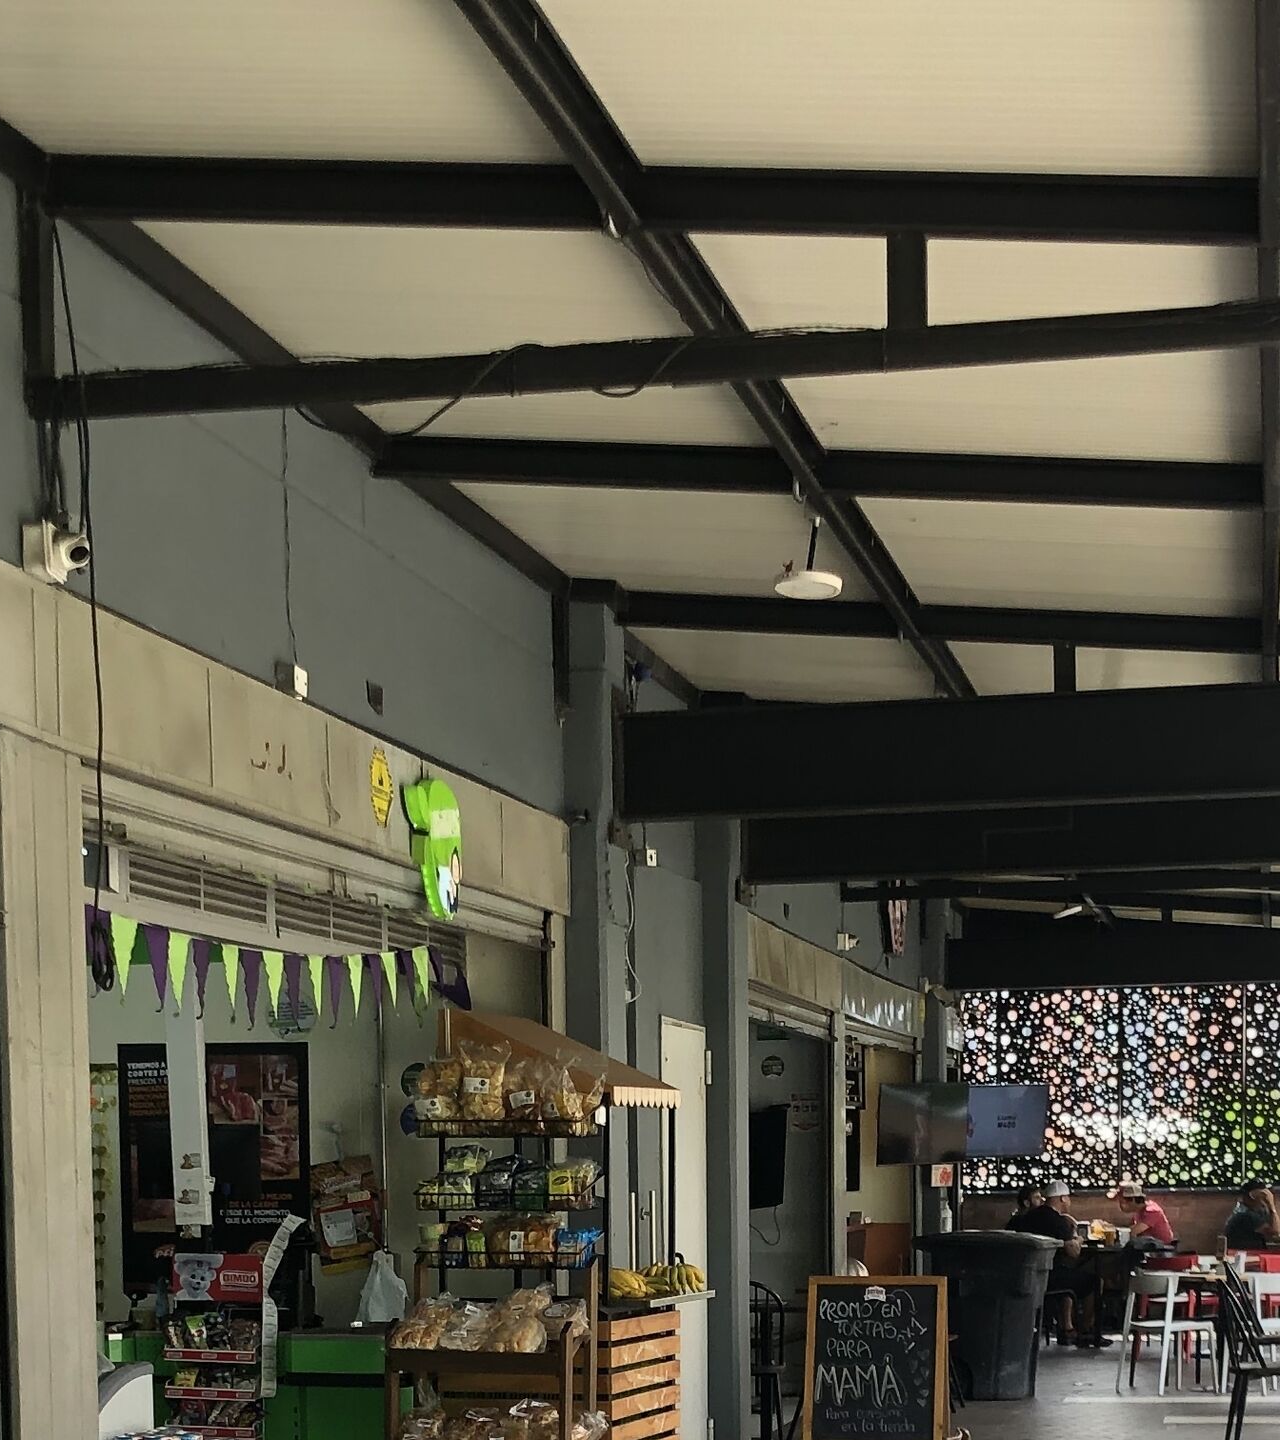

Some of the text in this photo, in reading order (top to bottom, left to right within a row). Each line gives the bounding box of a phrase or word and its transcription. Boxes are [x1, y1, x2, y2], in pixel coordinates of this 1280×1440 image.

[222, 1273, 257, 1284] BIMBO
[881, 1299, 902, 1318] EN
[833, 1320, 897, 1339] TORTAS
[826, 1338, 872, 1359] PARA
[841, 1423, 857, 1432] en
